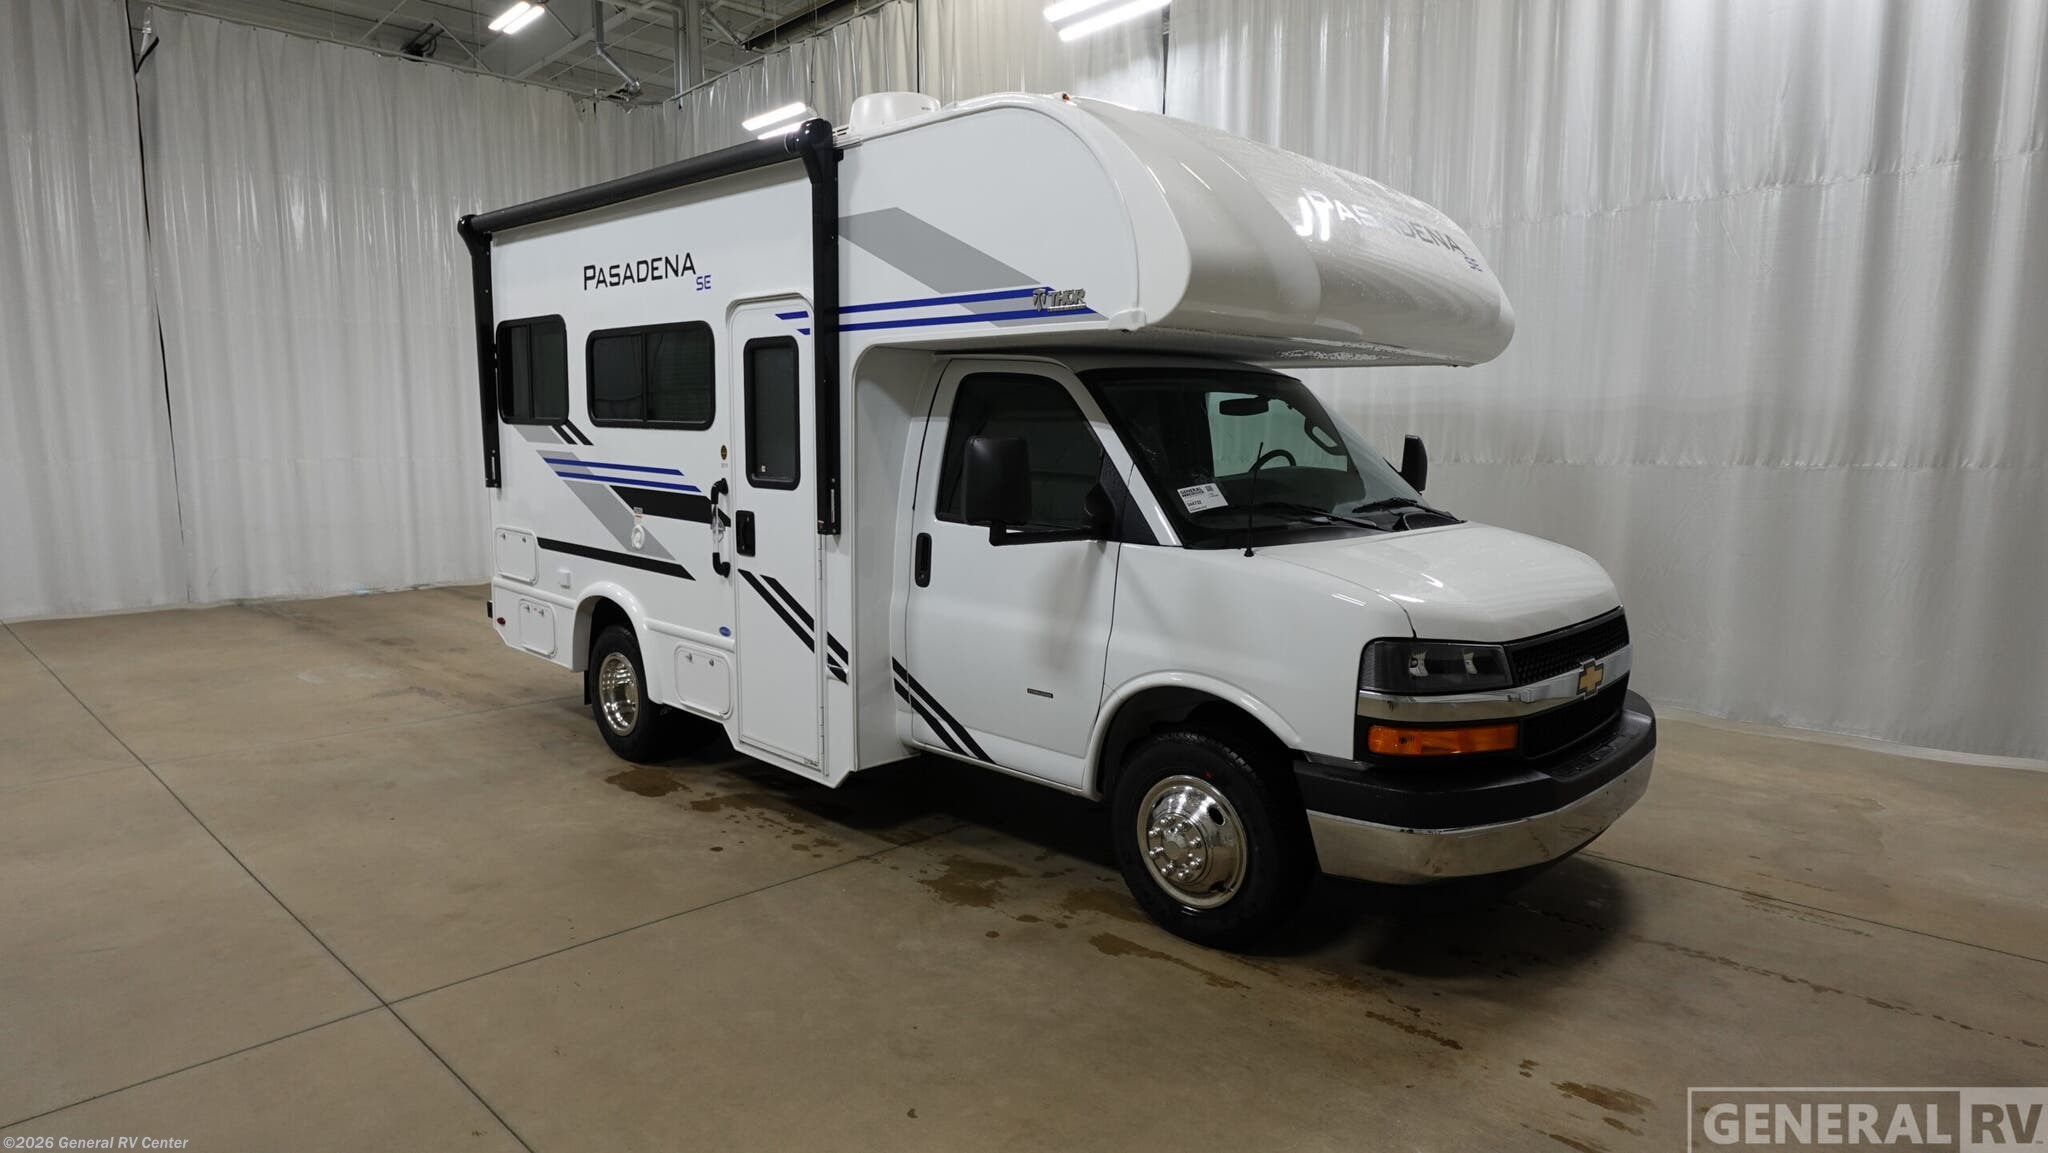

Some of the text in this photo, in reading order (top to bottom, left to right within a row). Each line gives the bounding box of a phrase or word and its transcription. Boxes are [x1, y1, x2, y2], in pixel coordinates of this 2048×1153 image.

[1301, 187, 1468, 257] PASDENA
[583, 252, 711, 291] PASADENA SE
[1048, 288, 1087, 306] THOR
